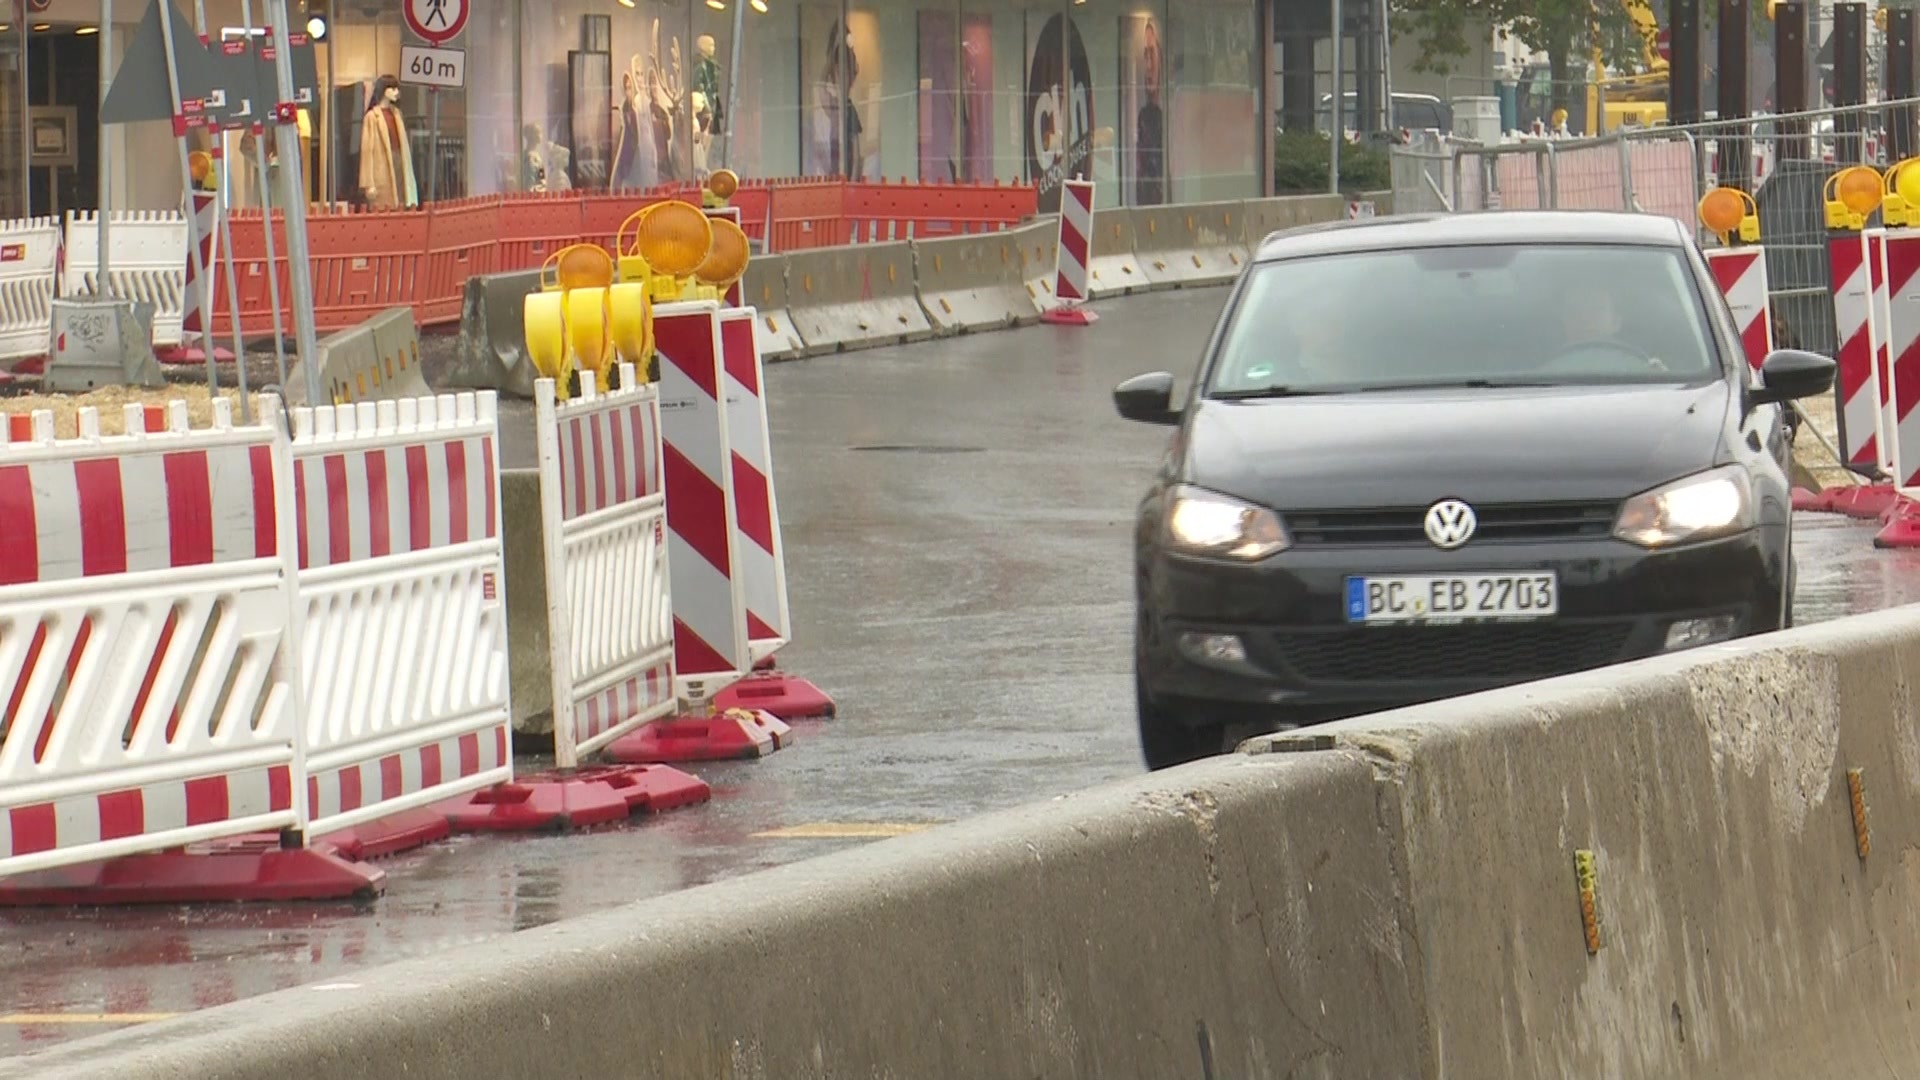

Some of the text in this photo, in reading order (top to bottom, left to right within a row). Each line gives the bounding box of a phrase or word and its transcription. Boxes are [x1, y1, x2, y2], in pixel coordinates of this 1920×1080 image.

[411, 55, 456, 78] 60 m
[1369, 577, 1551, 614] BC EB 2703
